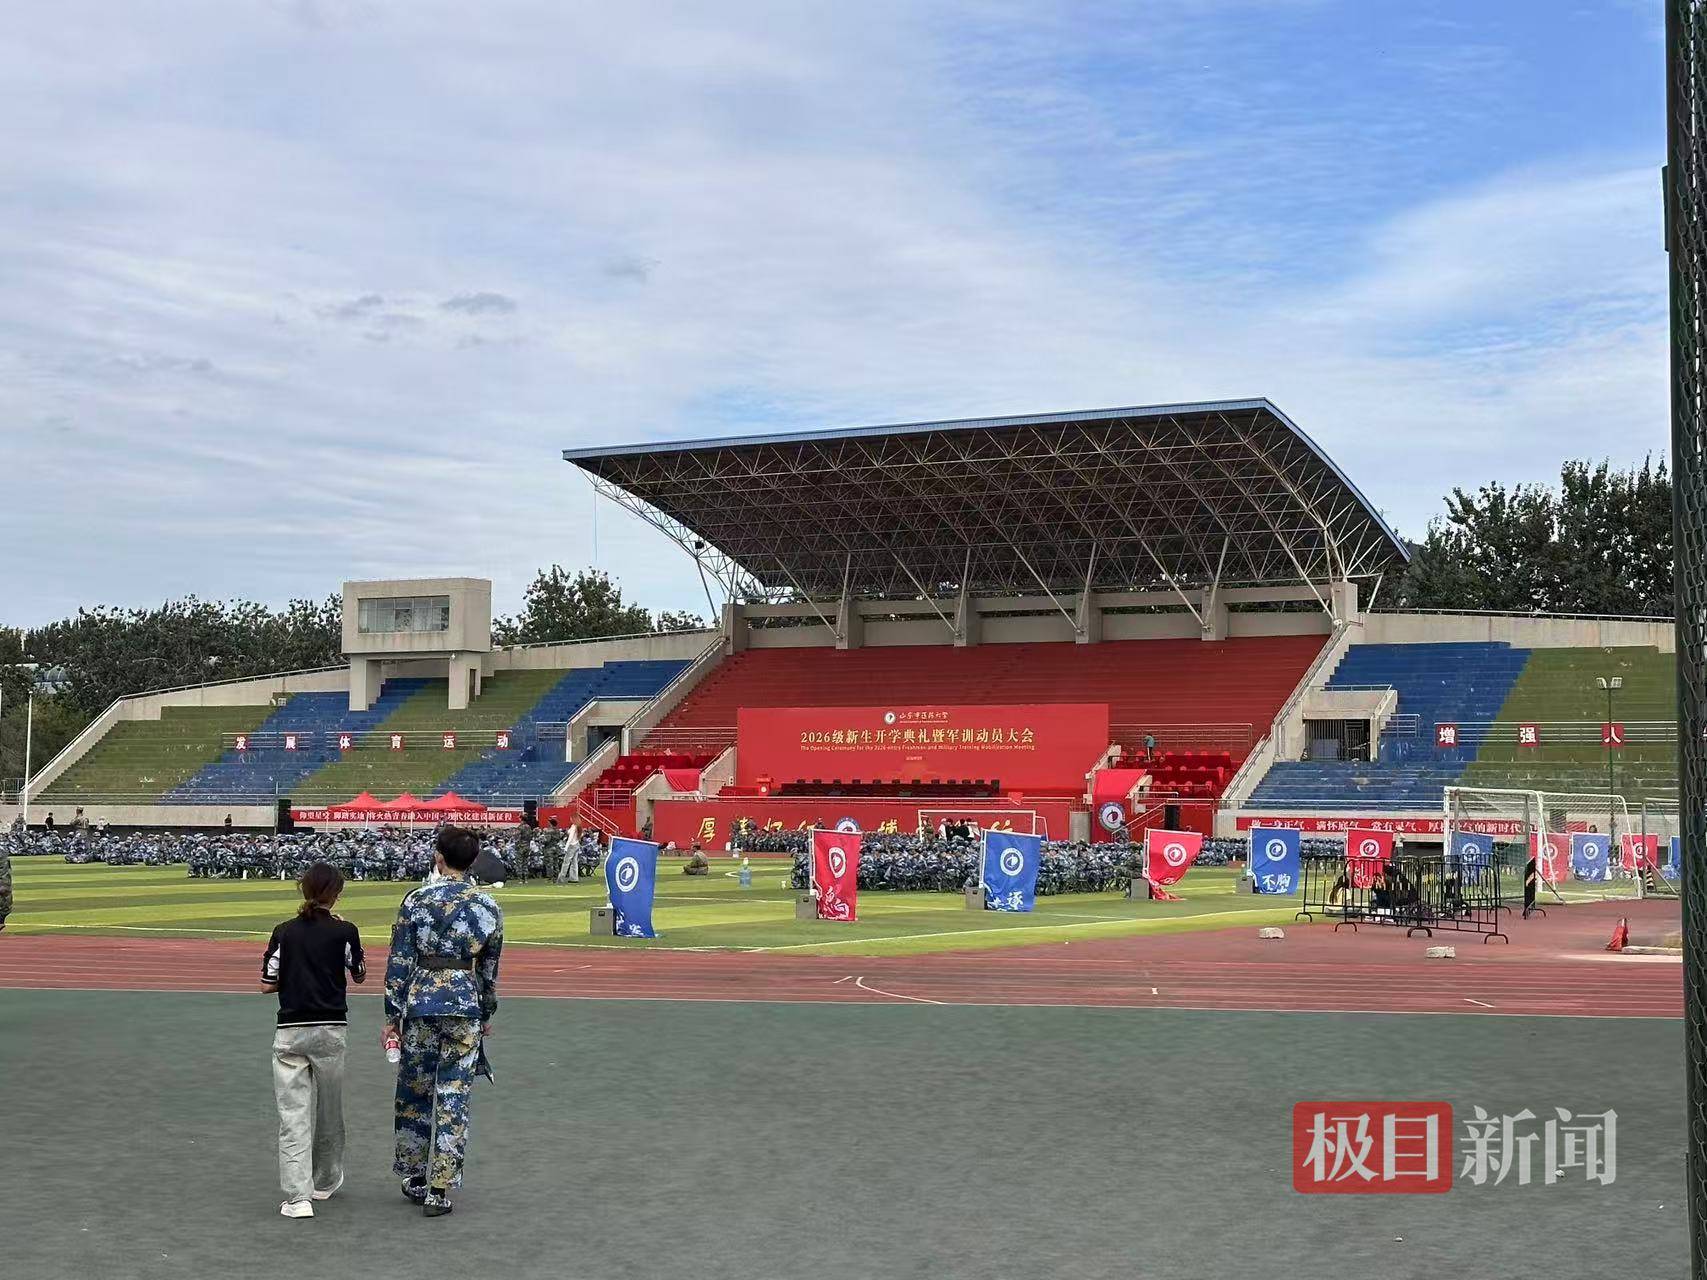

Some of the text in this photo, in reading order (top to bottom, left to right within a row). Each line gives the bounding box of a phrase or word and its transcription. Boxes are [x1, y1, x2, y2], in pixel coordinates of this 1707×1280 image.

[236, 733, 508, 749] 发 展 体 育 运 动
[800, 728, 1034, 744] 2026级新生开学典礼暨军训动员大会
[1439, 726, 1622, 744] 增 强 人
[697, 817, 716, 843] 厚
